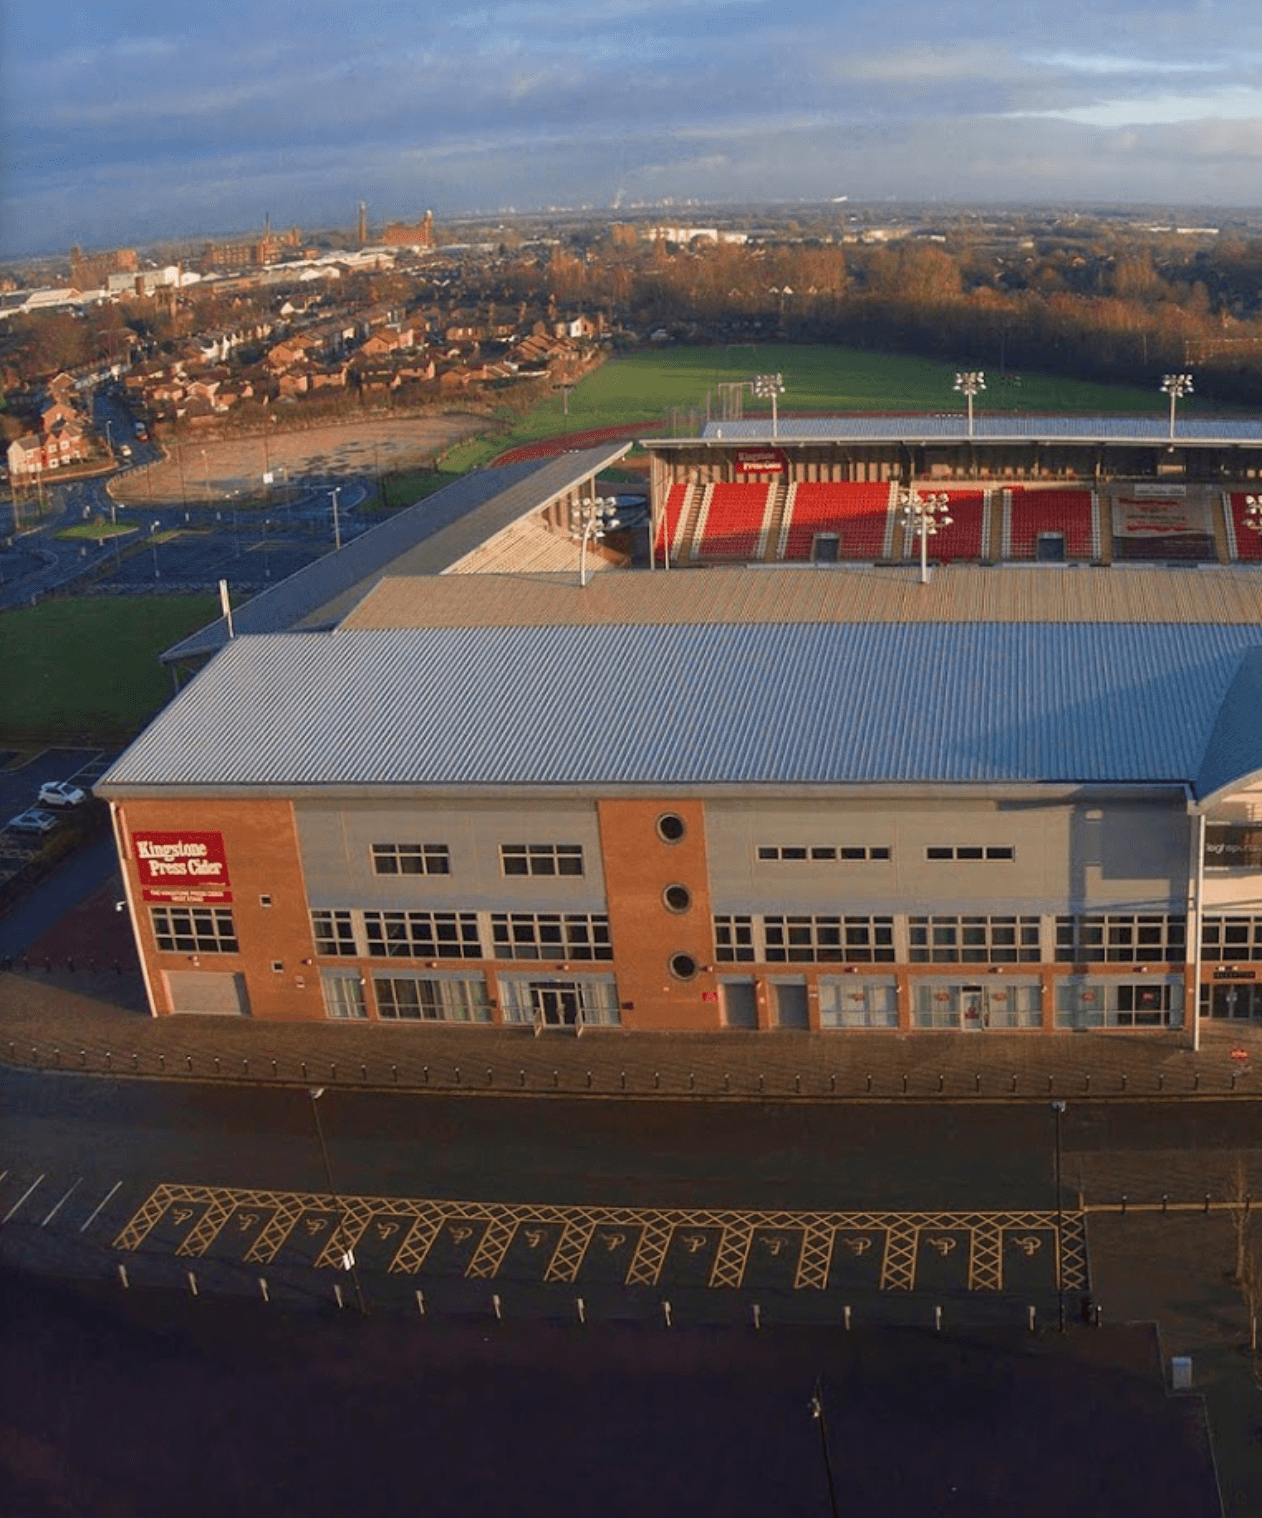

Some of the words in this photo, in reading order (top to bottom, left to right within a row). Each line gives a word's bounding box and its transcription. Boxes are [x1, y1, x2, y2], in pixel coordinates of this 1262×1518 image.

[136, 840, 207, 862] Kingstone
[148, 859, 187, 876] Press
[187, 859, 223, 875] Cider
